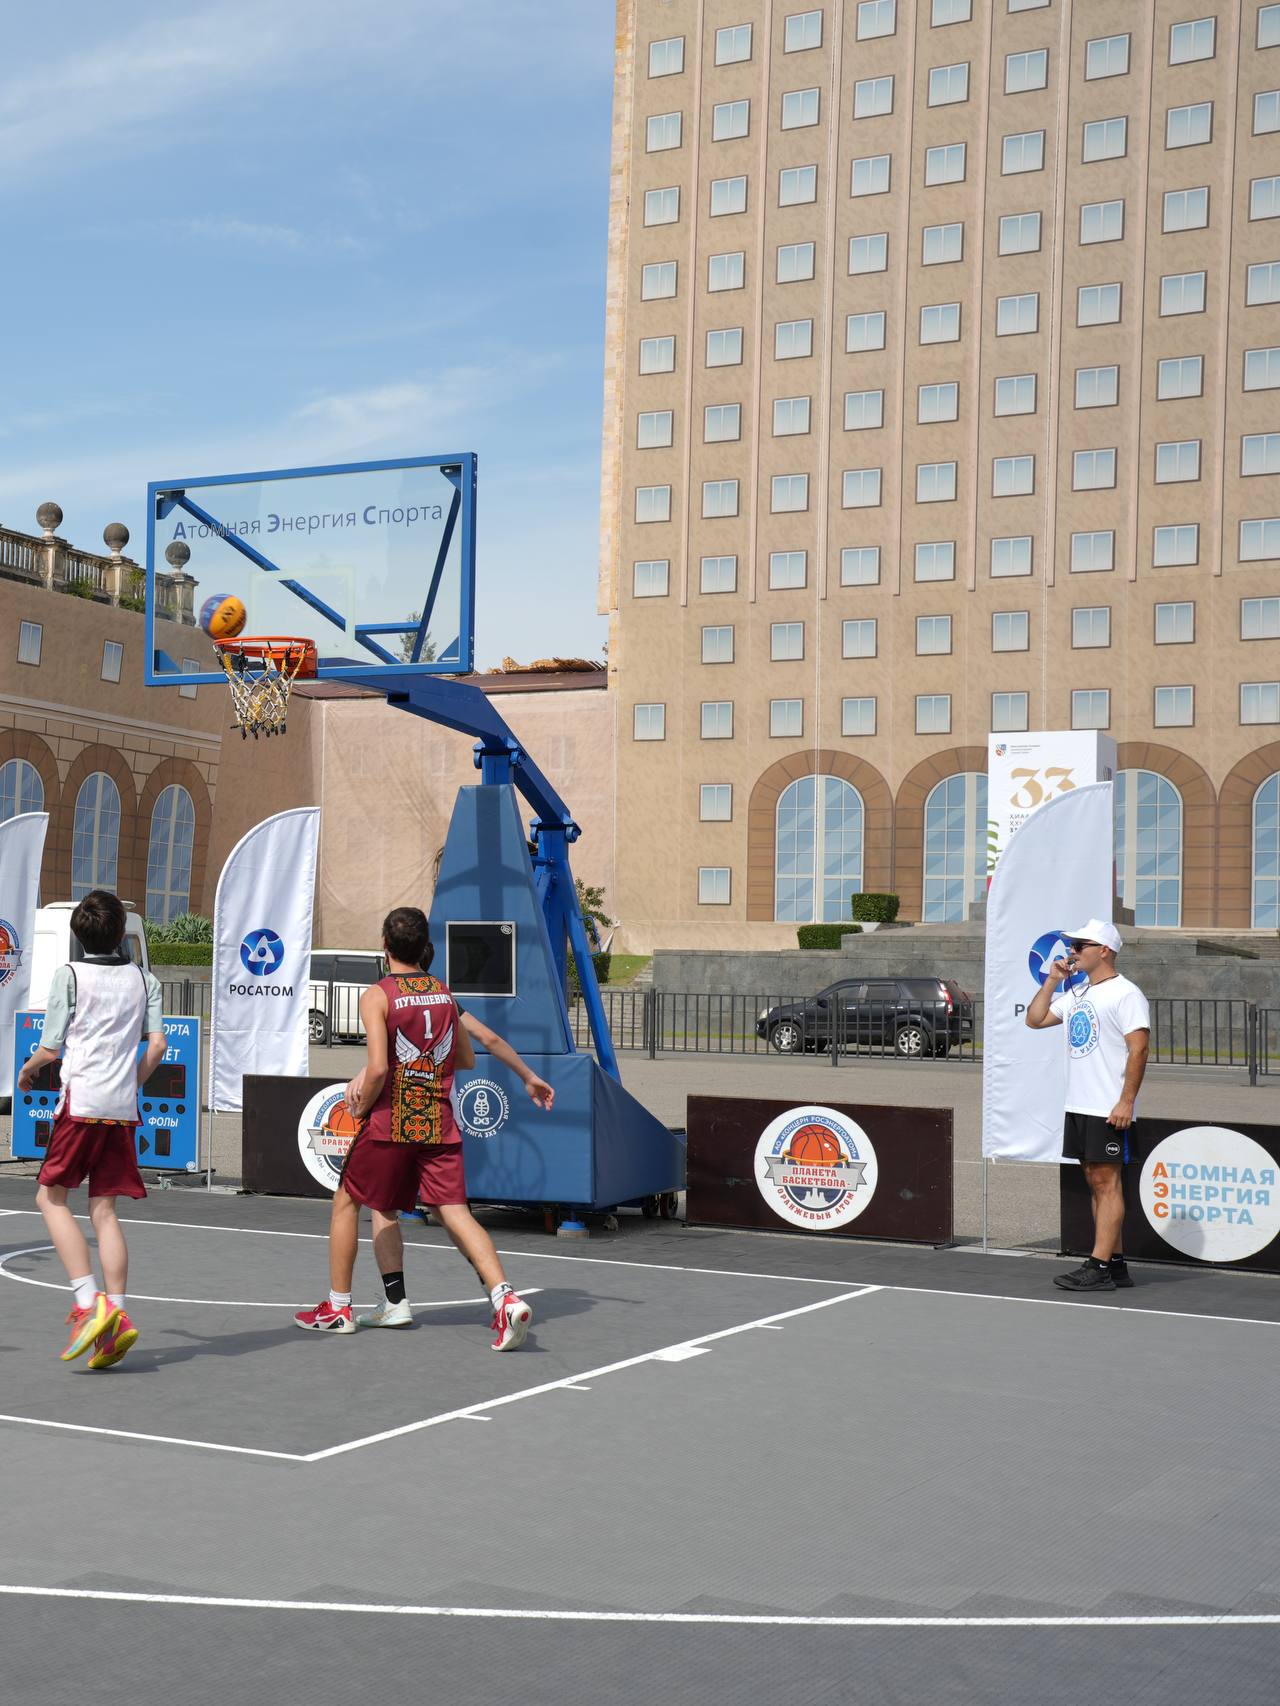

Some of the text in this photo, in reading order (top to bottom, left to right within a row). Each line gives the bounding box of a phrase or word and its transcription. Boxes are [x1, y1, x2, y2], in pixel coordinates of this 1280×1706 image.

[173, 504, 443, 541] Атомная Энергия Спорта
[229, 984, 294, 997] РОСАТОМ
[394, 993, 453, 1010] ЛУКАШЕВИЧ
[22, 1015, 45, 1031] АТО
[162, 1024, 190, 1037] ОРТА
[423, 1009, 433, 1039] 1
[148, 1116, 179, 1128] ФОЛЫ
[322, 1138, 351, 1146] ОРАНЖ
[792, 1167, 837, 1177] ПЛАНЕТА
[1152, 1162, 1275, 1186] АТОМНАЯ
[1153, 1182, 1270, 1206] ЭНЕРГИЯ
[777, 1188, 855, 1220] ОРАНЖЕВЫЙ АТОМ
[1153, 1202, 1255, 1226] СПОРТА
